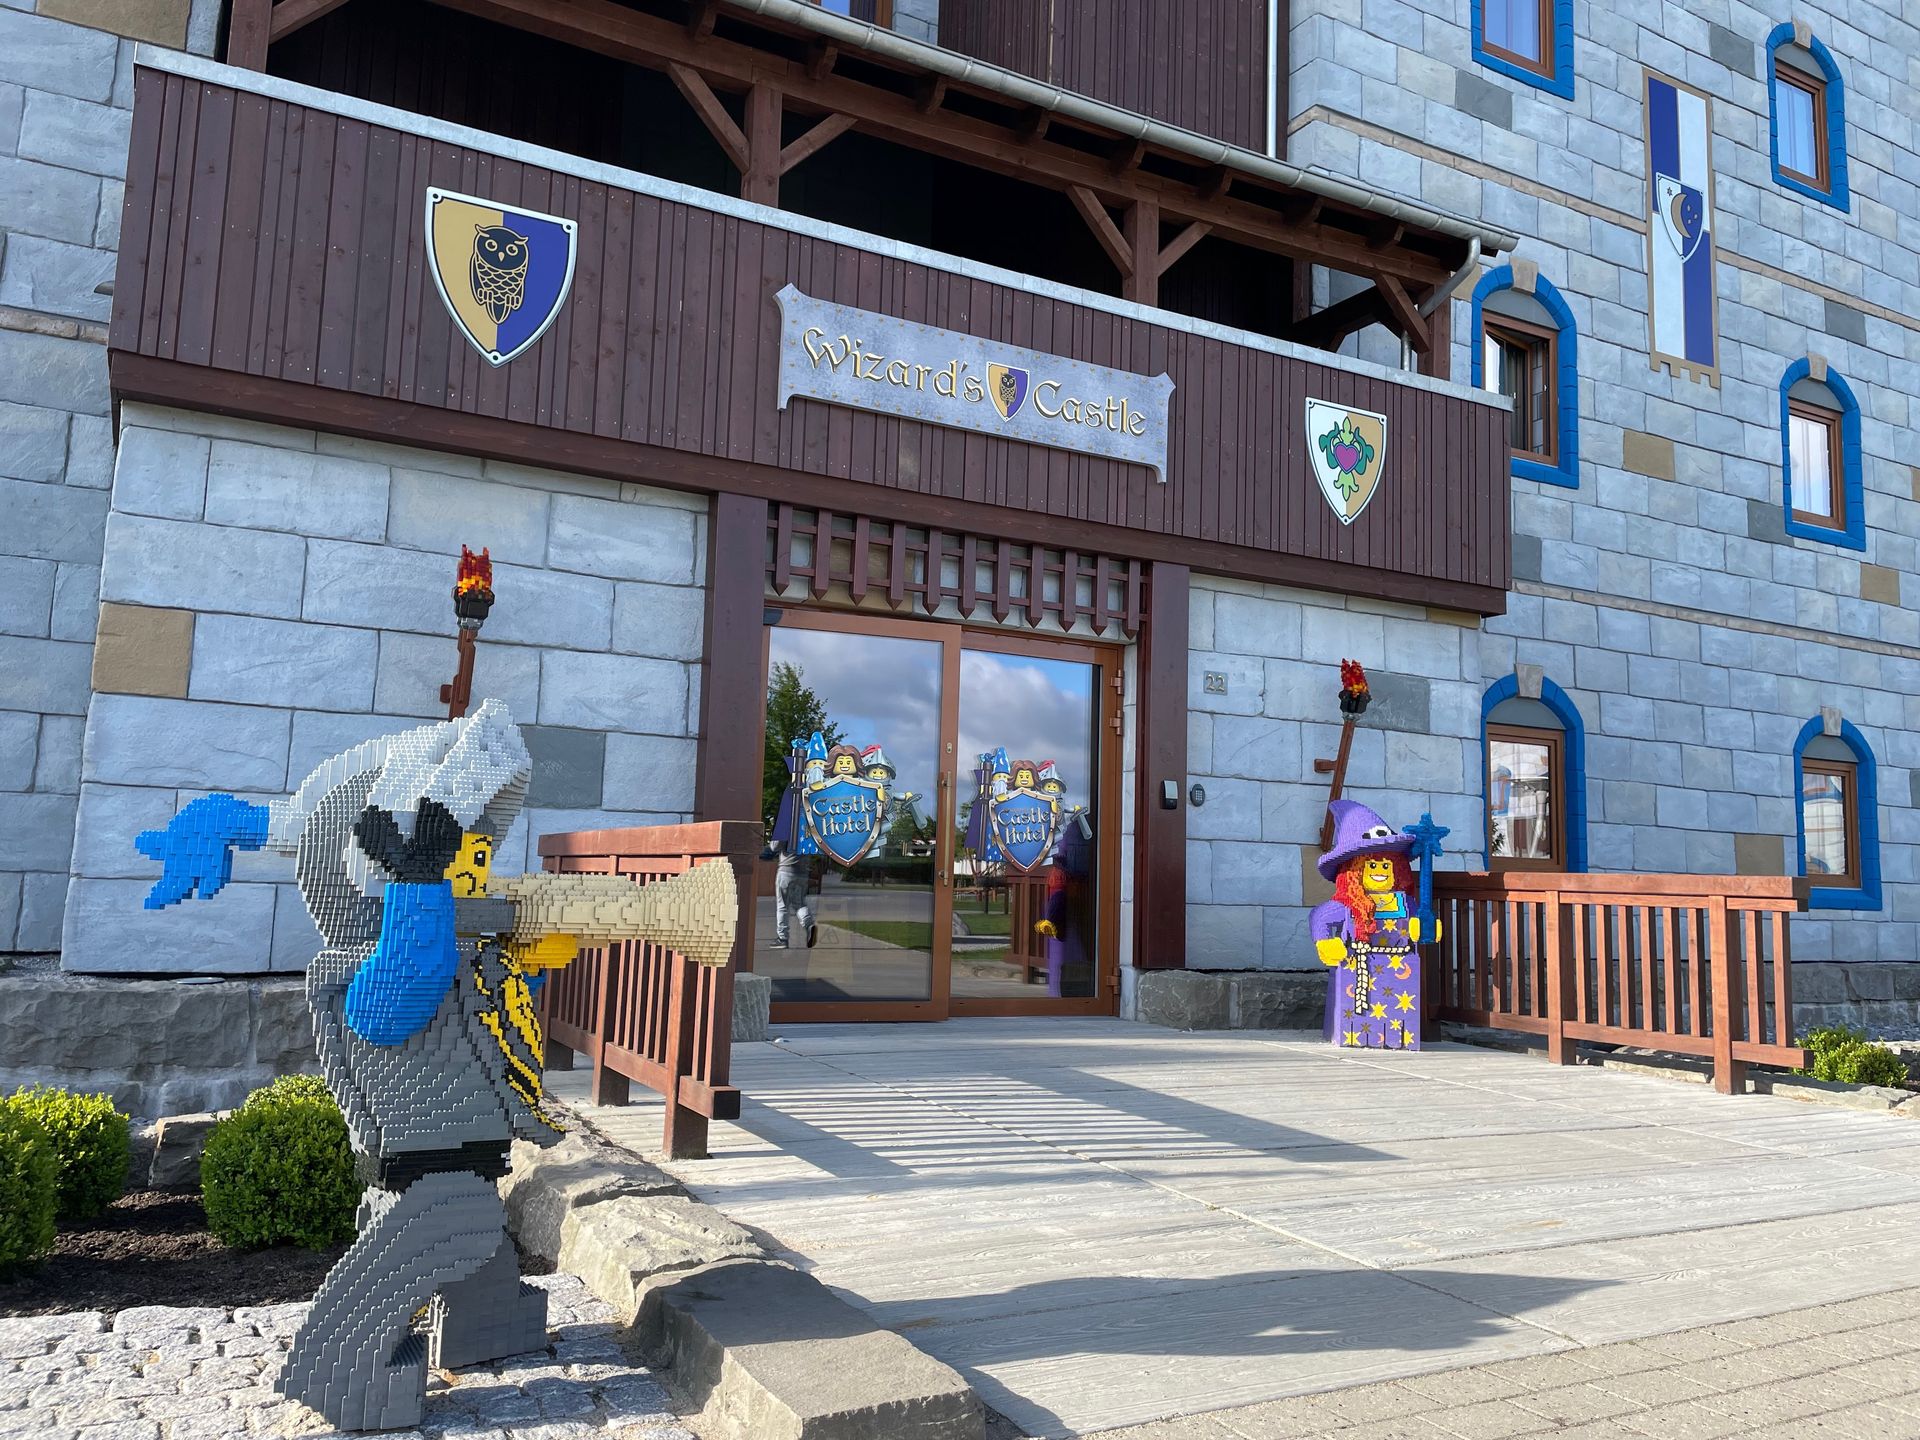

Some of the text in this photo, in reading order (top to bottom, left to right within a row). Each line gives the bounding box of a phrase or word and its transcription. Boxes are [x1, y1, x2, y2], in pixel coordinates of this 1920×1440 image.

[802, 326, 1146, 437] Wizard's Castle
[1205, 673, 1226, 693] 22
[812, 794, 876, 816] Castle
[822, 814, 871, 836] Hotel
[997, 807, 1050, 827] Castle
[1005, 824, 1046, 845] Hotel
